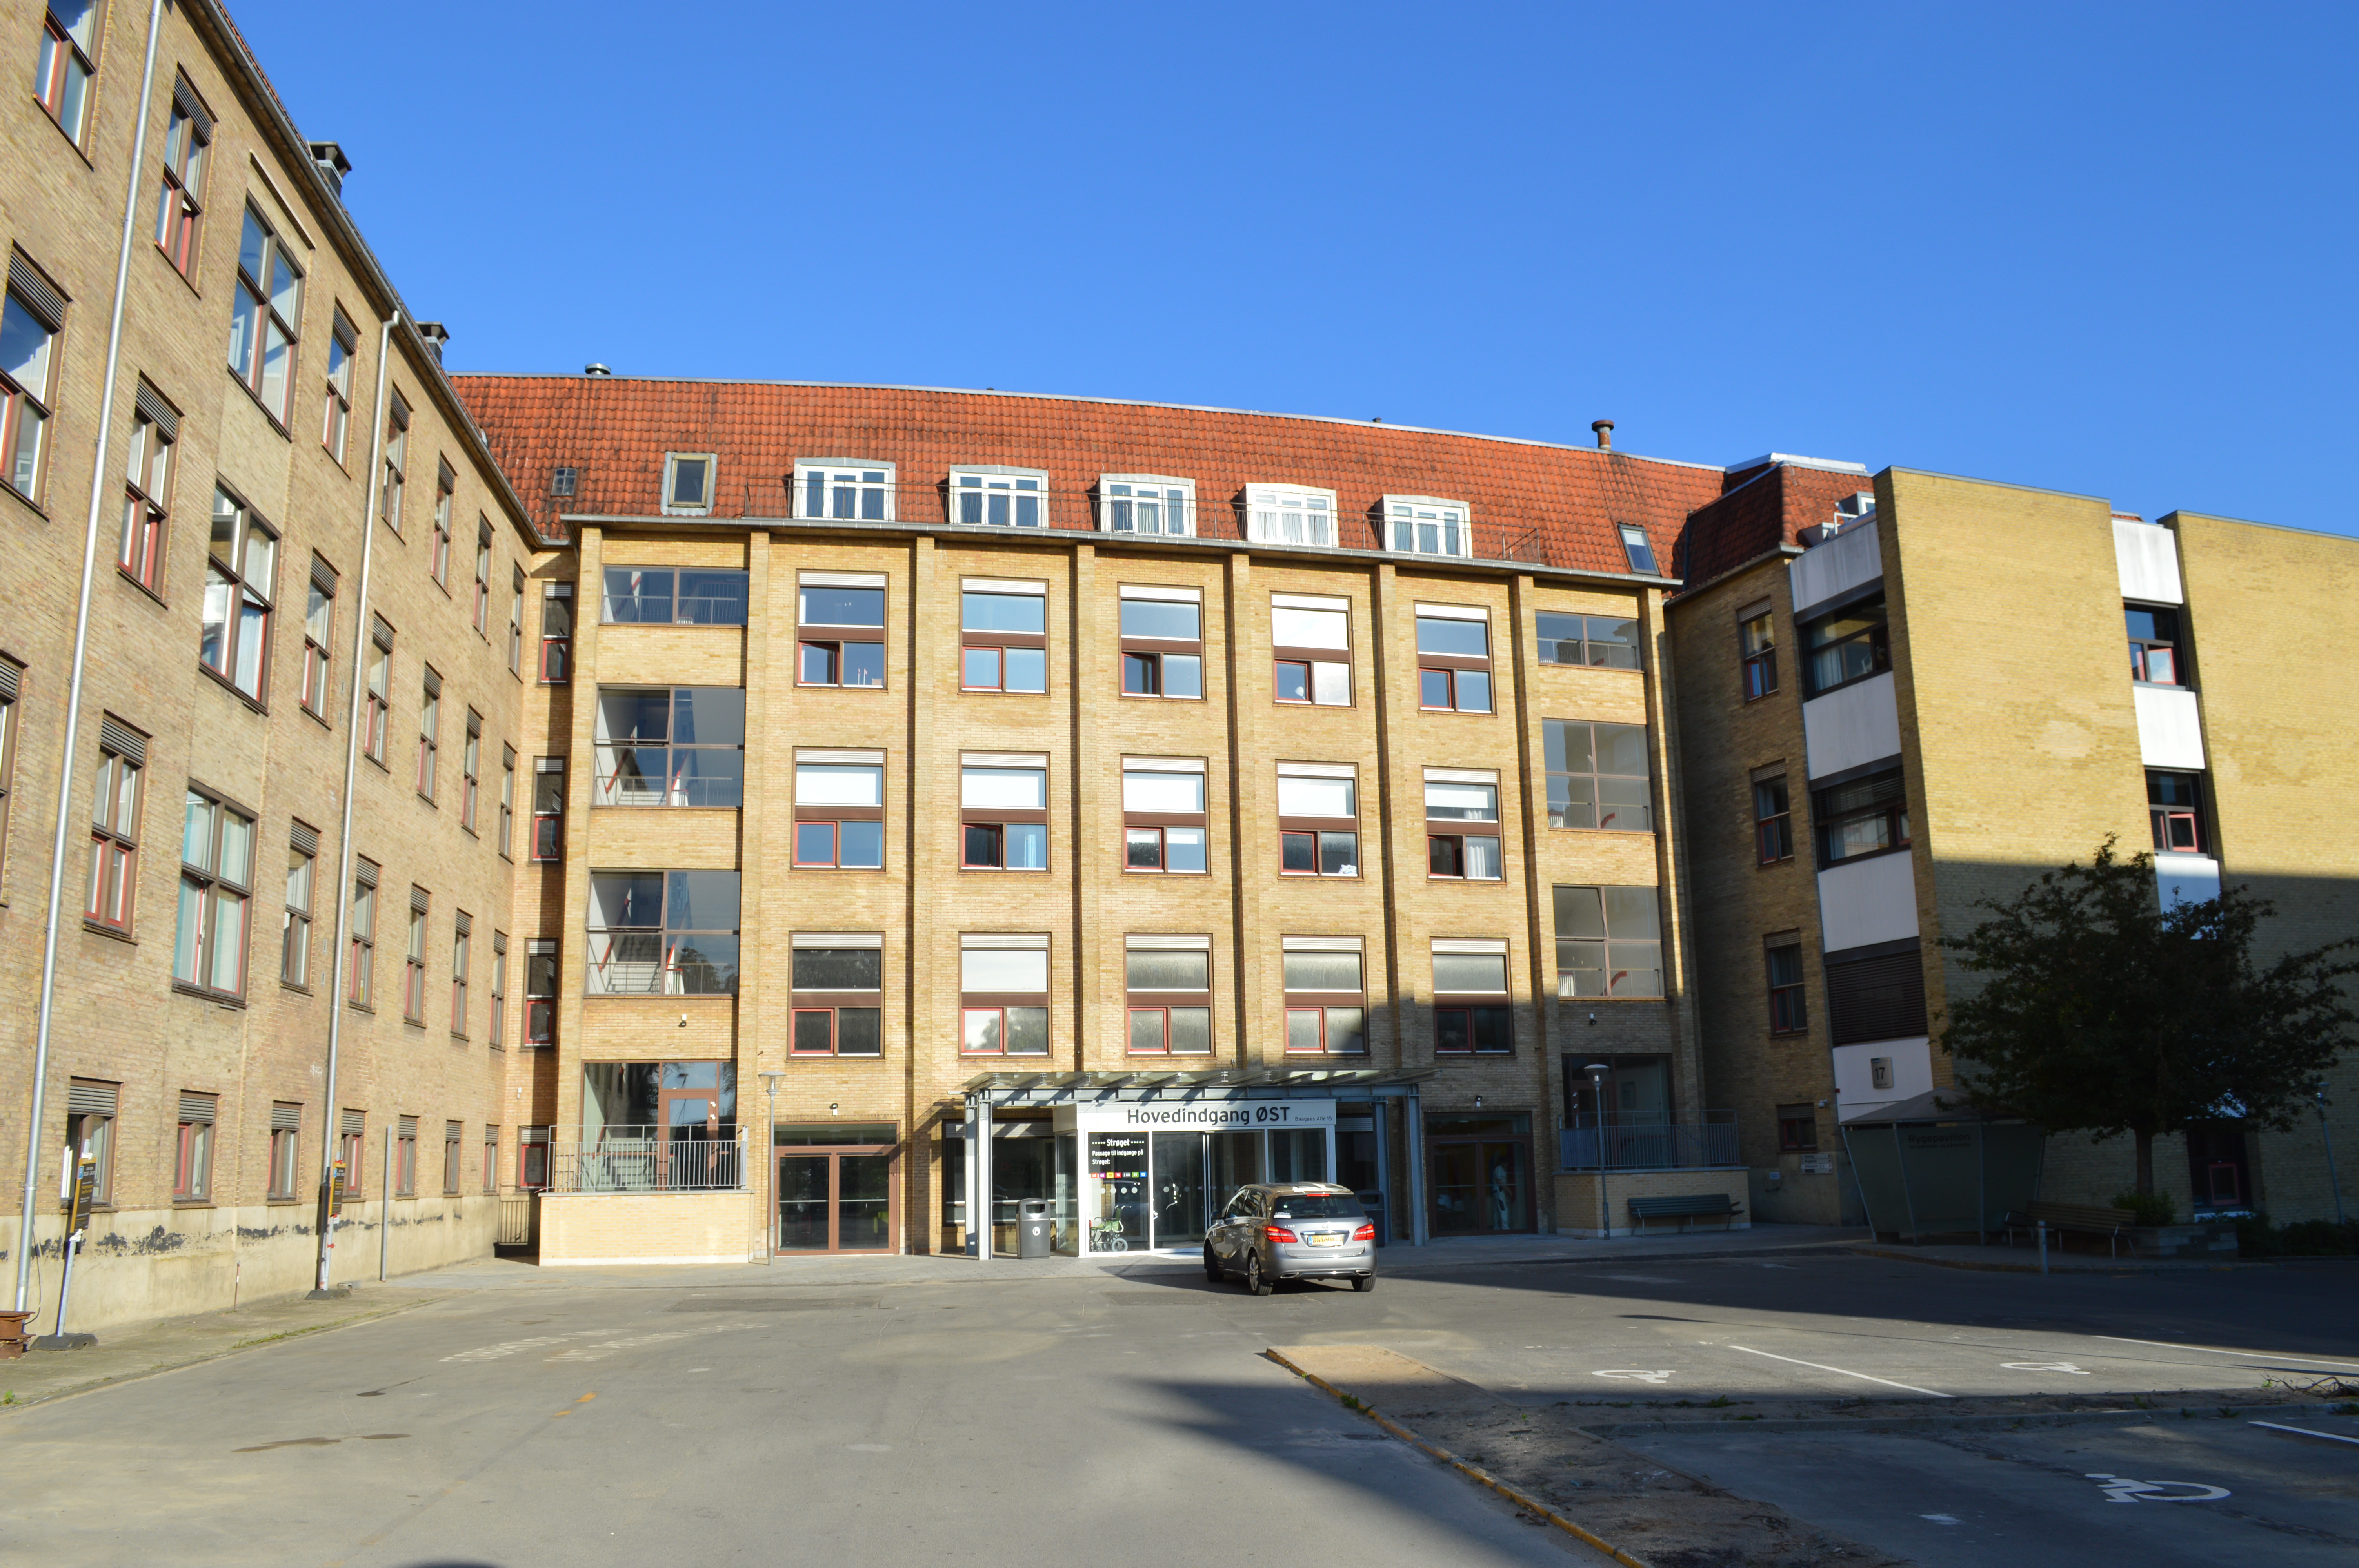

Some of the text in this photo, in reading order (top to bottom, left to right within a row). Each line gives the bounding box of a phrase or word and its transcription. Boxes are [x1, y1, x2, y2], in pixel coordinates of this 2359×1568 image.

[1876, 1067, 1885, 1080] 17
[1127, 1107, 1290, 1125] Hovedindgang ØST
[1107, 1138, 1130, 1148] Strøget
[1908, 1133, 1970, 1144] Rygepavillon
